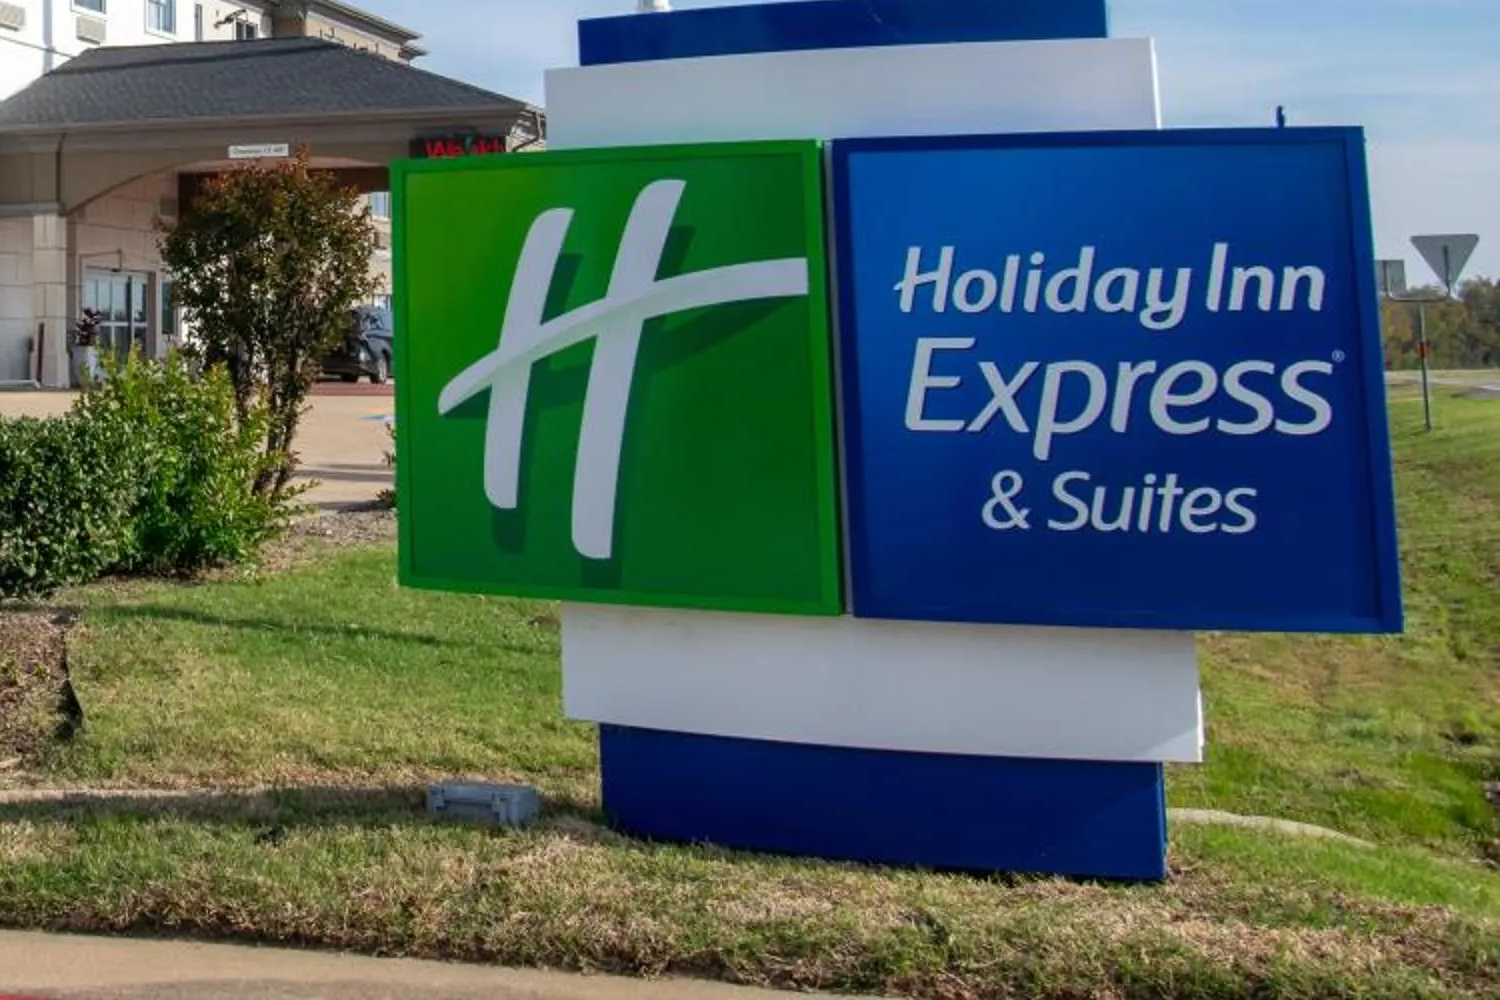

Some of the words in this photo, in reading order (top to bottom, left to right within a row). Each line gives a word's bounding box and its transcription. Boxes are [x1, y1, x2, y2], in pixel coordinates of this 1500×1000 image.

[893, 245, 1193, 330] Holiday
[1205, 242, 1325, 312] Inn
[438, 179, 809, 560] H
[981, 469, 1031, 530] &
[1047, 471, 1258, 534] Suites
